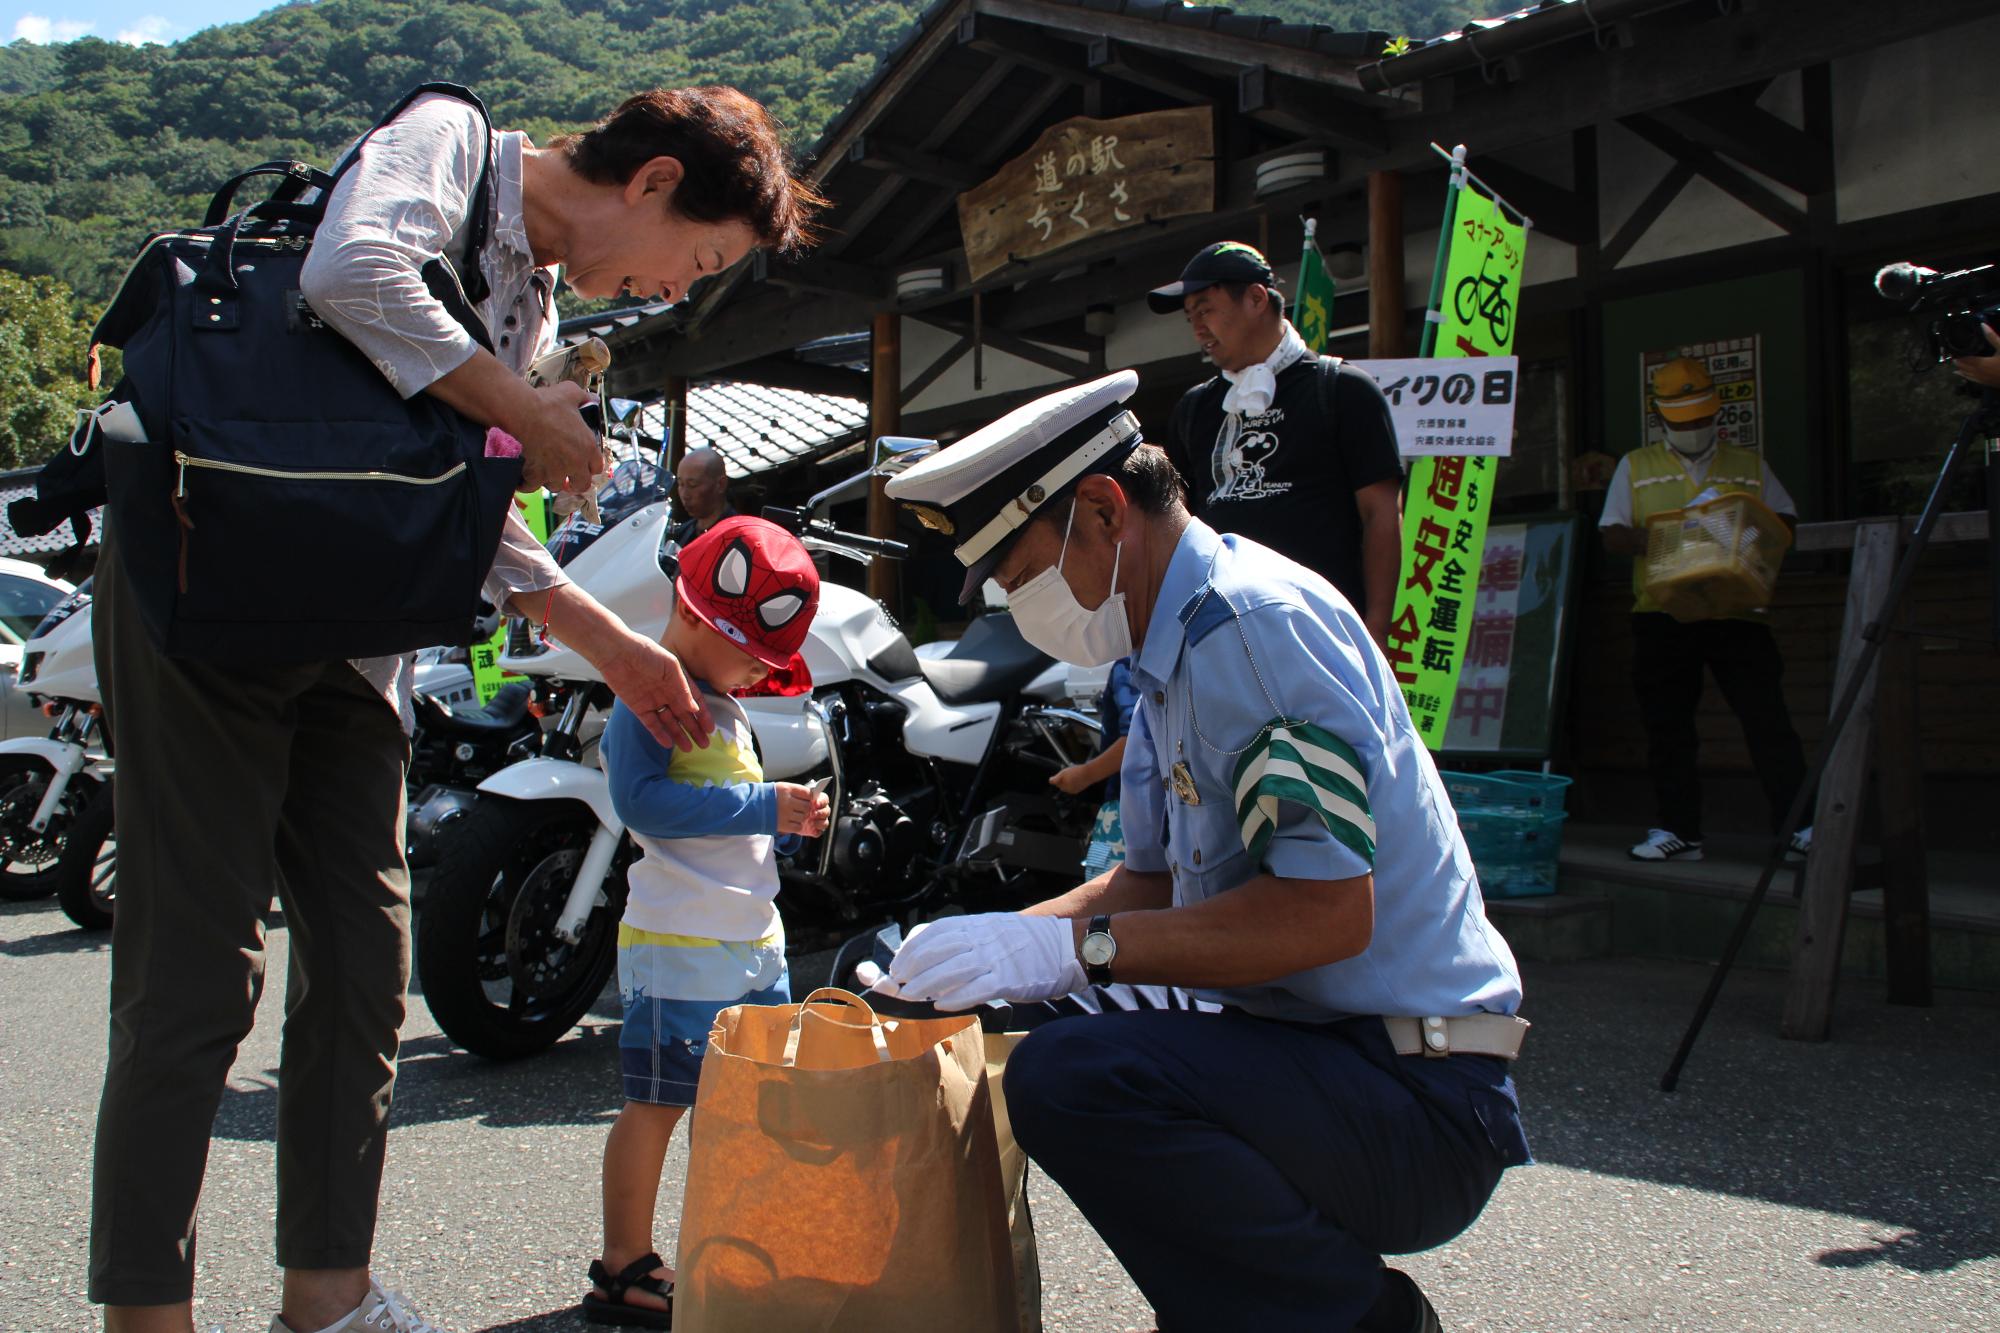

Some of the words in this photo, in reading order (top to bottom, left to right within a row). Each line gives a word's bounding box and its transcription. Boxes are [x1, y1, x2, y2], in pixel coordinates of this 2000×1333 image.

[1034, 136, 1125, 193] 道の駅
[1027, 181, 1131, 241] ちくさ
[1370, 370, 1514, 406] イクの日
